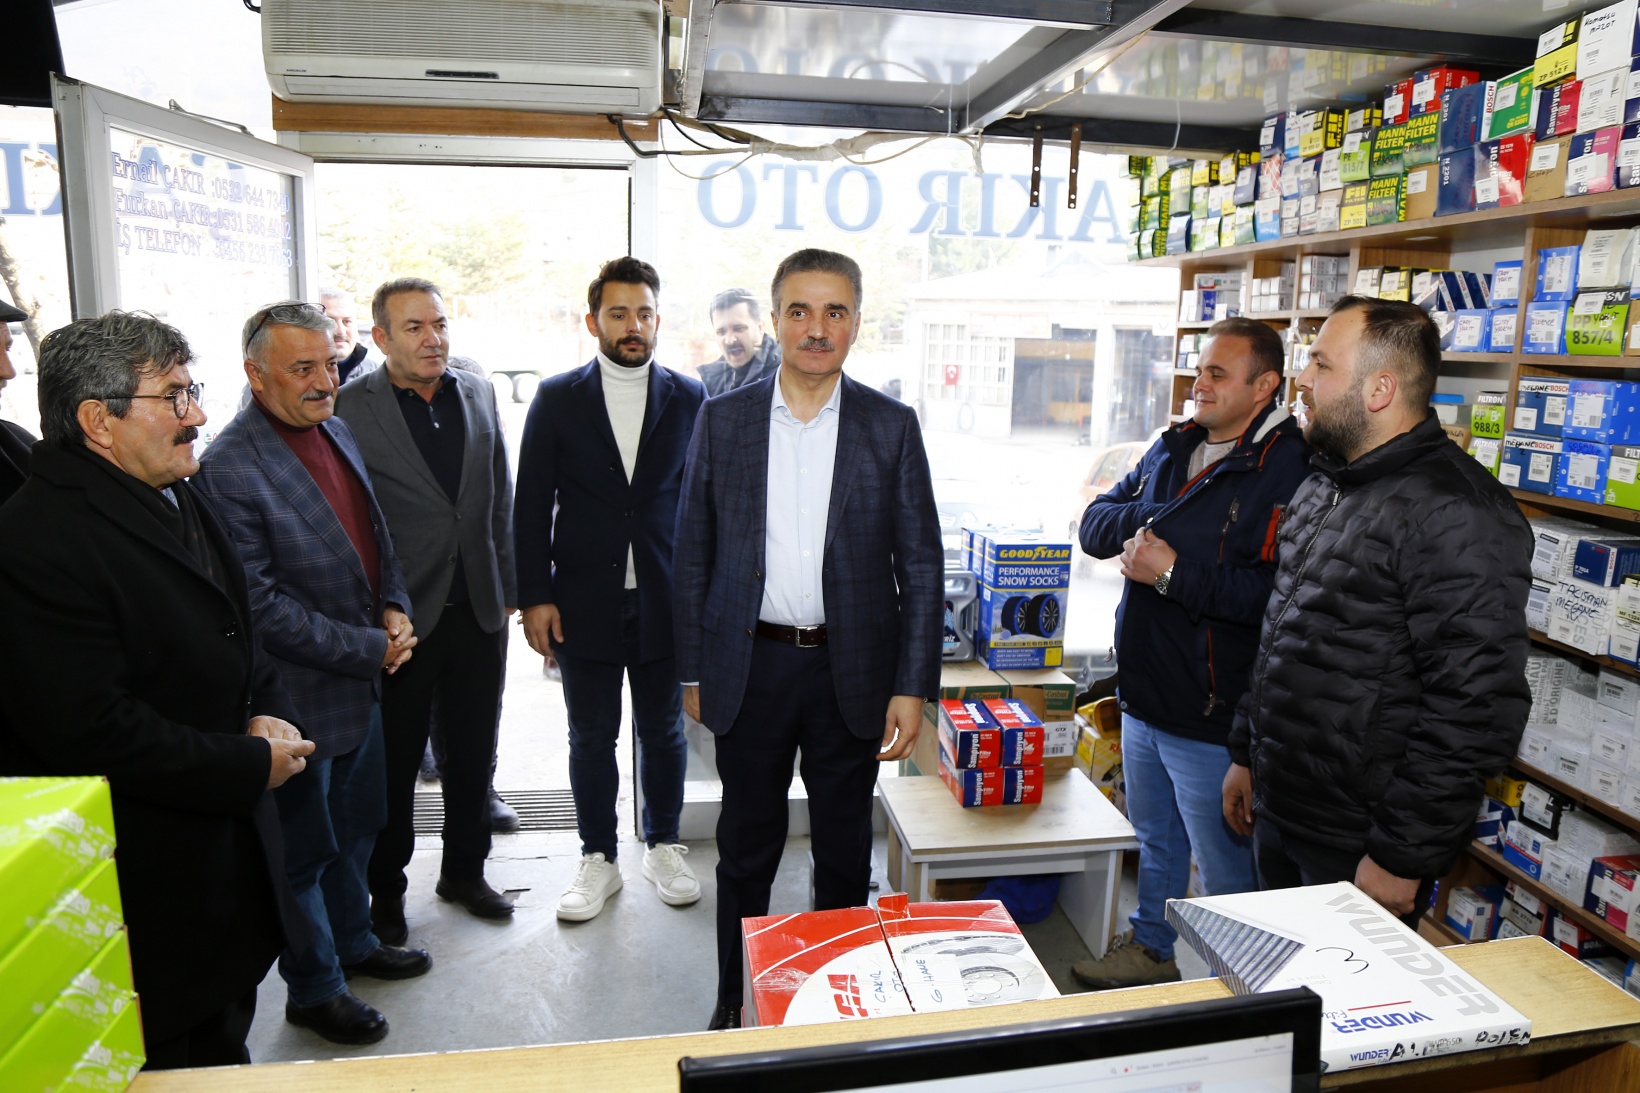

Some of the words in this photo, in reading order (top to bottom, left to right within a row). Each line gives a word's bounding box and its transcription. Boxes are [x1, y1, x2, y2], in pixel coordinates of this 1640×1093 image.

[1539, 74, 1548, 82] ZP
[1550, 68, 1562, 78] 512
[1486, 86, 1495, 114] BOSCH
[1407, 114, 1438, 128] MANN
[1378, 127, 1406, 140] MANN
[1406, 125, 1437, 140] FILTER
[1376, 138, 1404, 150] FILTER
[164, 165, 206, 196] ÇAKIR
[1371, 177, 1399, 190] MANN
[1368, 188, 1397, 200] FILTER
[1398, 177, 1408, 222] MANN
[114, 188, 168, 220] Furkan
[135, 226, 201, 257] TELEFON
[1573, 315, 1592, 328] PP
[1572, 330, 1614, 346] 857/4
[1478, 396, 1504, 404] FILTRON
[1474, 410, 1486, 420] PP
[1474, 422, 1500, 434] 988/3
[1534, 442, 1555, 450] BOSCH
[1000, 546, 1070, 560] GOODYEAR
[998, 568, 1060, 576] PERFORMANCE
[998, 576, 1028, 586] SNOW
[1030, 576, 1060, 586] SOCKS
[1324, 892, 1500, 1017] WUNDER
[1332, 1011, 1434, 1034] WUNDER
[1350, 1049, 1390, 1062] WUNDER
